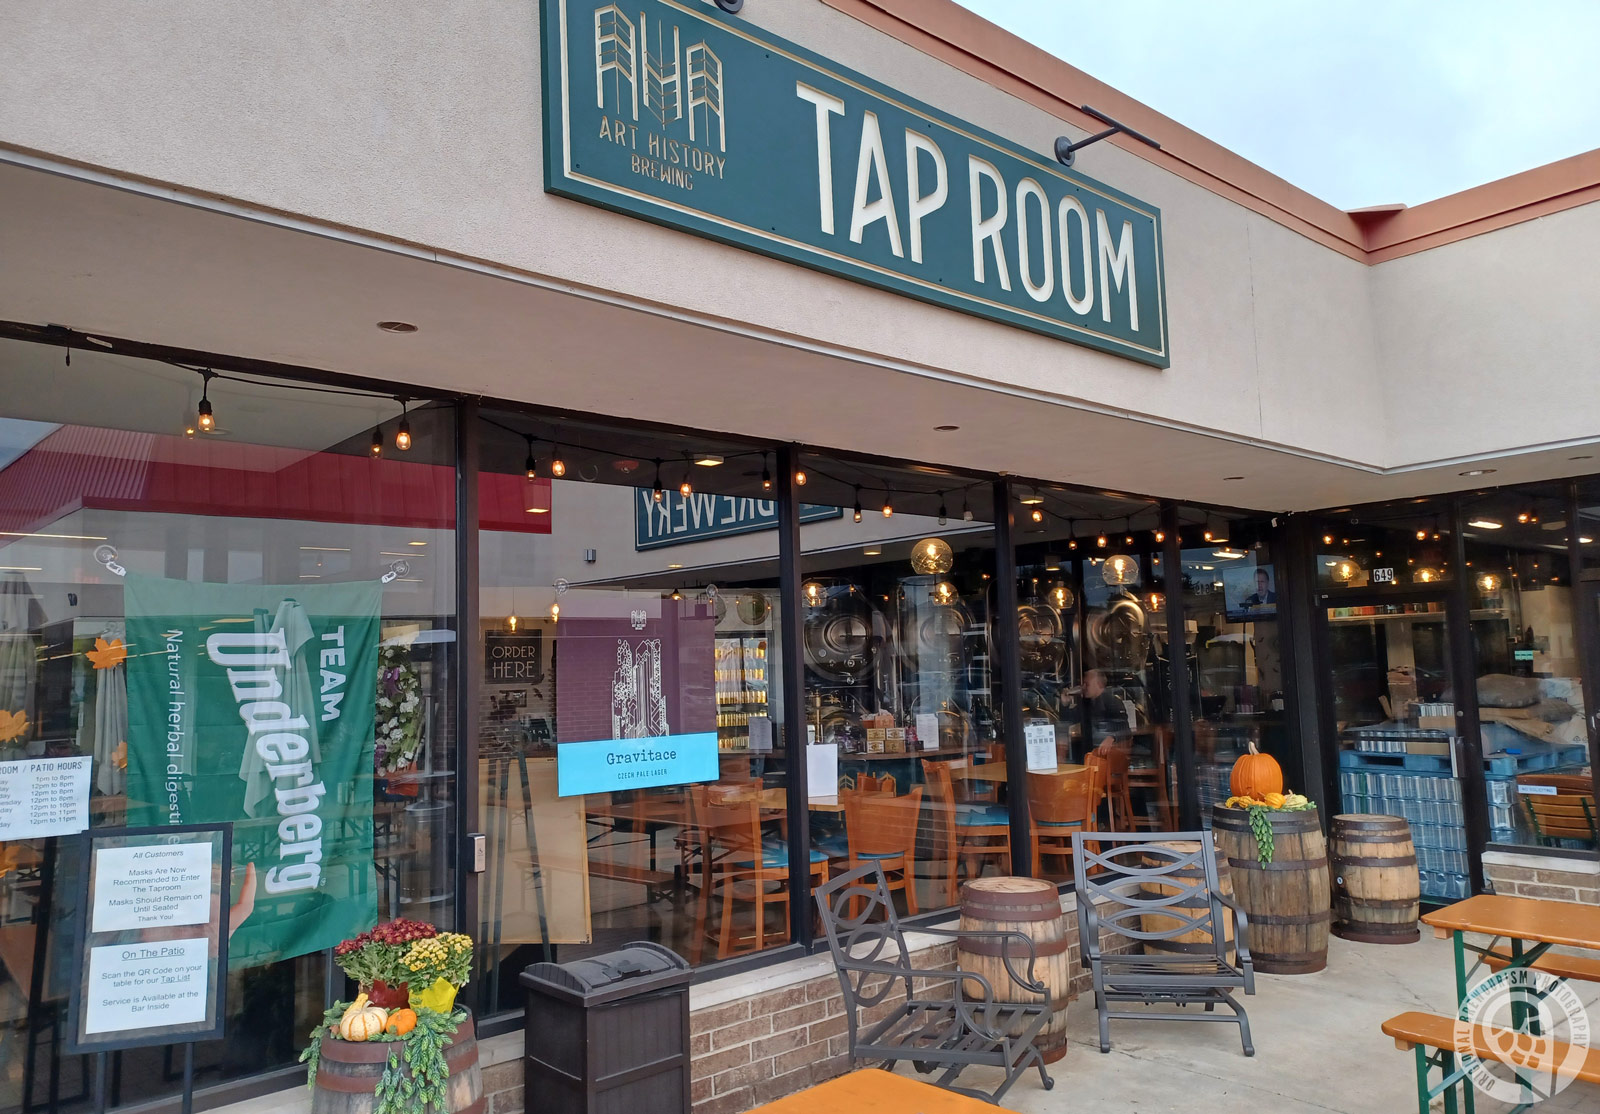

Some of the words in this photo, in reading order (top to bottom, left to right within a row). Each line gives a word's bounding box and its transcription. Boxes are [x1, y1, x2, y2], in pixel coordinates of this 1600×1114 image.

[600, 115, 638, 150] ART
[649, 132, 726, 179] HISTORY
[631, 154, 693, 190] BREWING
[796, 80, 948, 264] TAP
[968, 154, 1140, 332] ROOM
[1374, 568, 1393, 581] 649
[492, 645, 536, 658] ORDER
[167, 629, 185, 695] Natural
[319, 625, 347, 722] TEAM
[492, 661, 535, 678] HERE
[167, 701, 186, 757] herbal
[206, 627, 326, 895] Underberg
[606, 749, 677, 765] Gravitace
[31, 763, 54, 772] PATIO
[57, 761, 82, 770] HOURS
[618, 772, 634, 780] CZECH
[636, 770, 649, 778] PALE
[651, 768, 668, 777] LAGER
[165, 763, 183, 845] digestie
[144, 850, 184, 859] Customers
[128, 868, 153, 876] Masks
[155, 867, 168, 875] Are
[170, 866, 187, 874] Now
[113, 876, 170, 886] Recommended
[180, 874, 200, 882] Enter
[149, 884, 182, 892] Taproom
[108, 898, 133, 906] Masks
[135, 896, 162, 904] Should
[163, 894, 192, 902] Remain
[133, 905, 150, 913] Until
[152, 903, 179, 912] Seated
[121, 950, 136, 960] On
[140, 949, 158, 958] The
[160, 947, 185, 956] Patio
[102, 972, 121, 980] Scan
[123, 970, 136, 978] the
[138, 968, 150, 976] QR
[152, 967, 173, 975] Code
[186, 964, 202, 973] your
[113, 979, 132, 987] table
[134, 978, 144, 986] for
[161, 975, 176, 984] Tap
[177, 974, 191, 982] List
[102, 998, 131, 1007] Service
[141, 993, 176, 1002] Available
[187, 990, 199, 998] the
[131, 1005, 145, 1013] Bar
[147, 1002, 170, 1011] Inside
